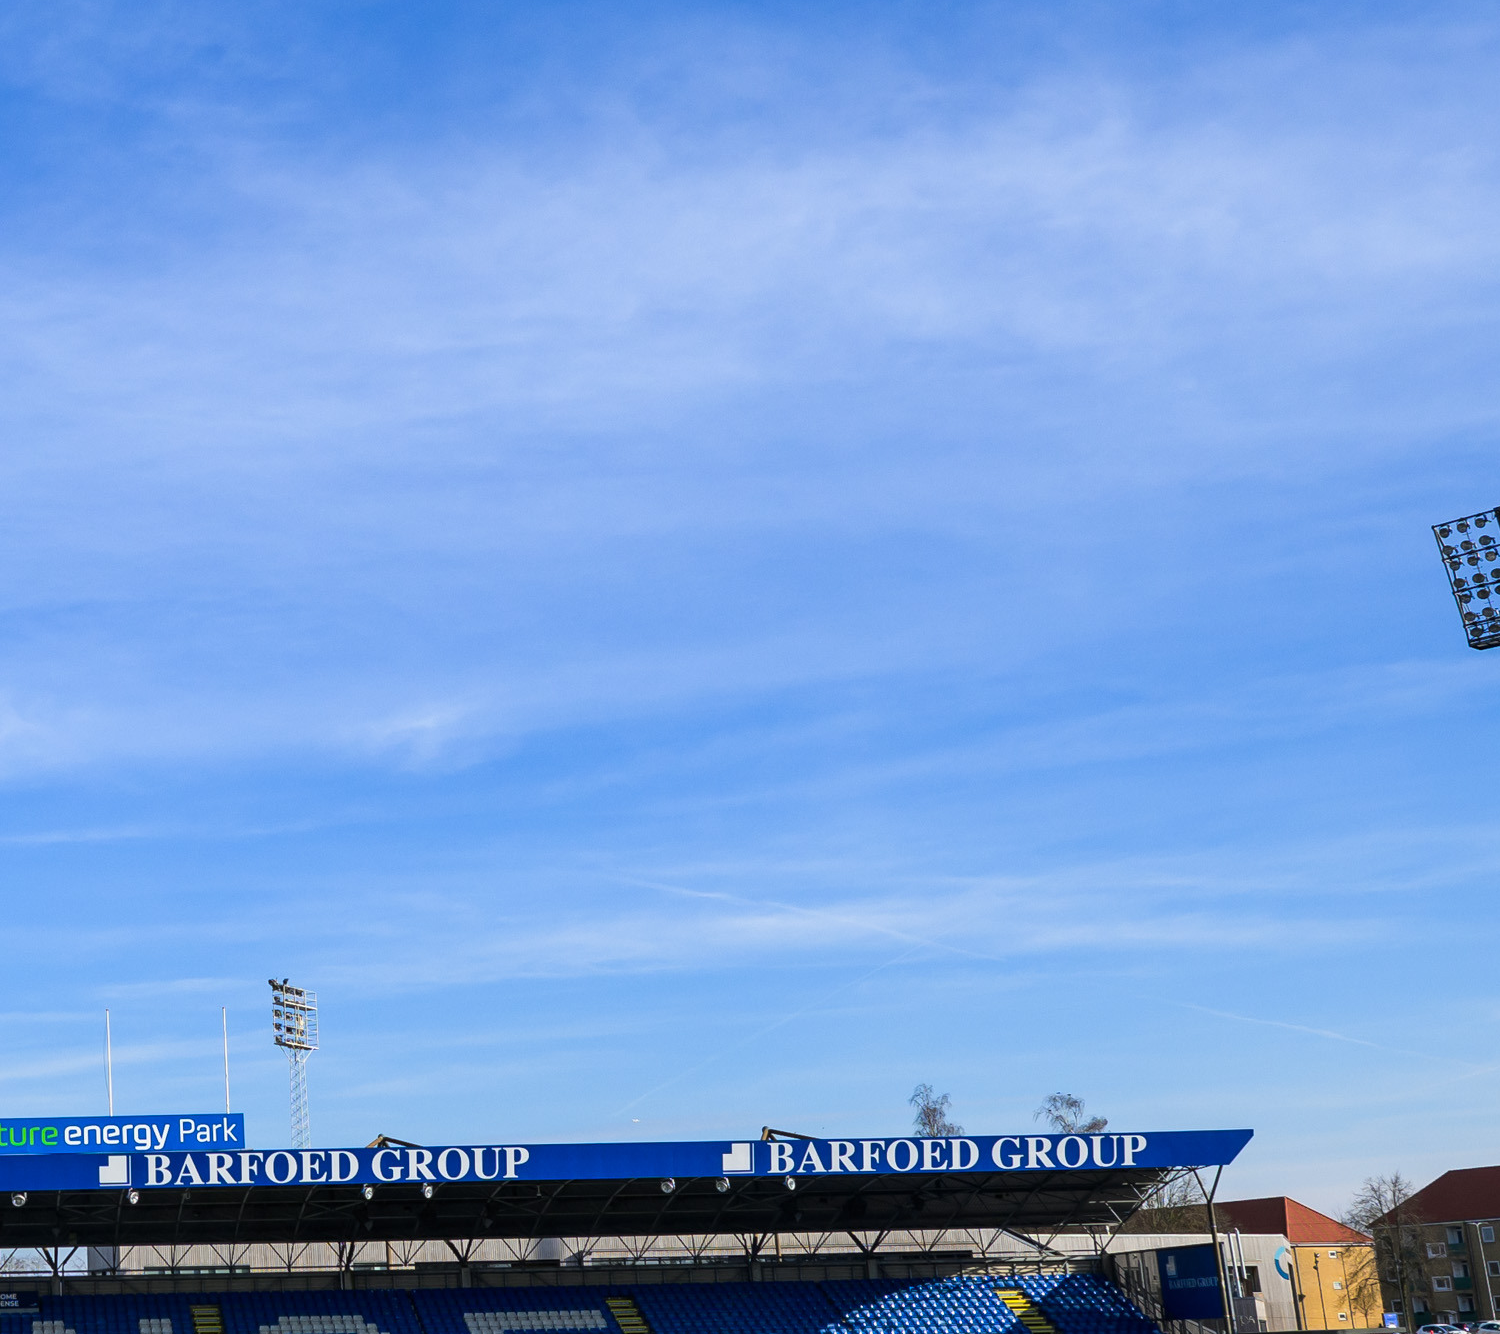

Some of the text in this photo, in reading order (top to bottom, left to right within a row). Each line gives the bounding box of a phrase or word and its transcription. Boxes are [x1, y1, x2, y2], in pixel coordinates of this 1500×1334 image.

[64, 1123, 170, 1150] energy
[179, 1117, 238, 1143] Park
[144, 1147, 530, 1186] BARFOED GROUP
[766, 1135, 1148, 1174] BARFOED GROUP
